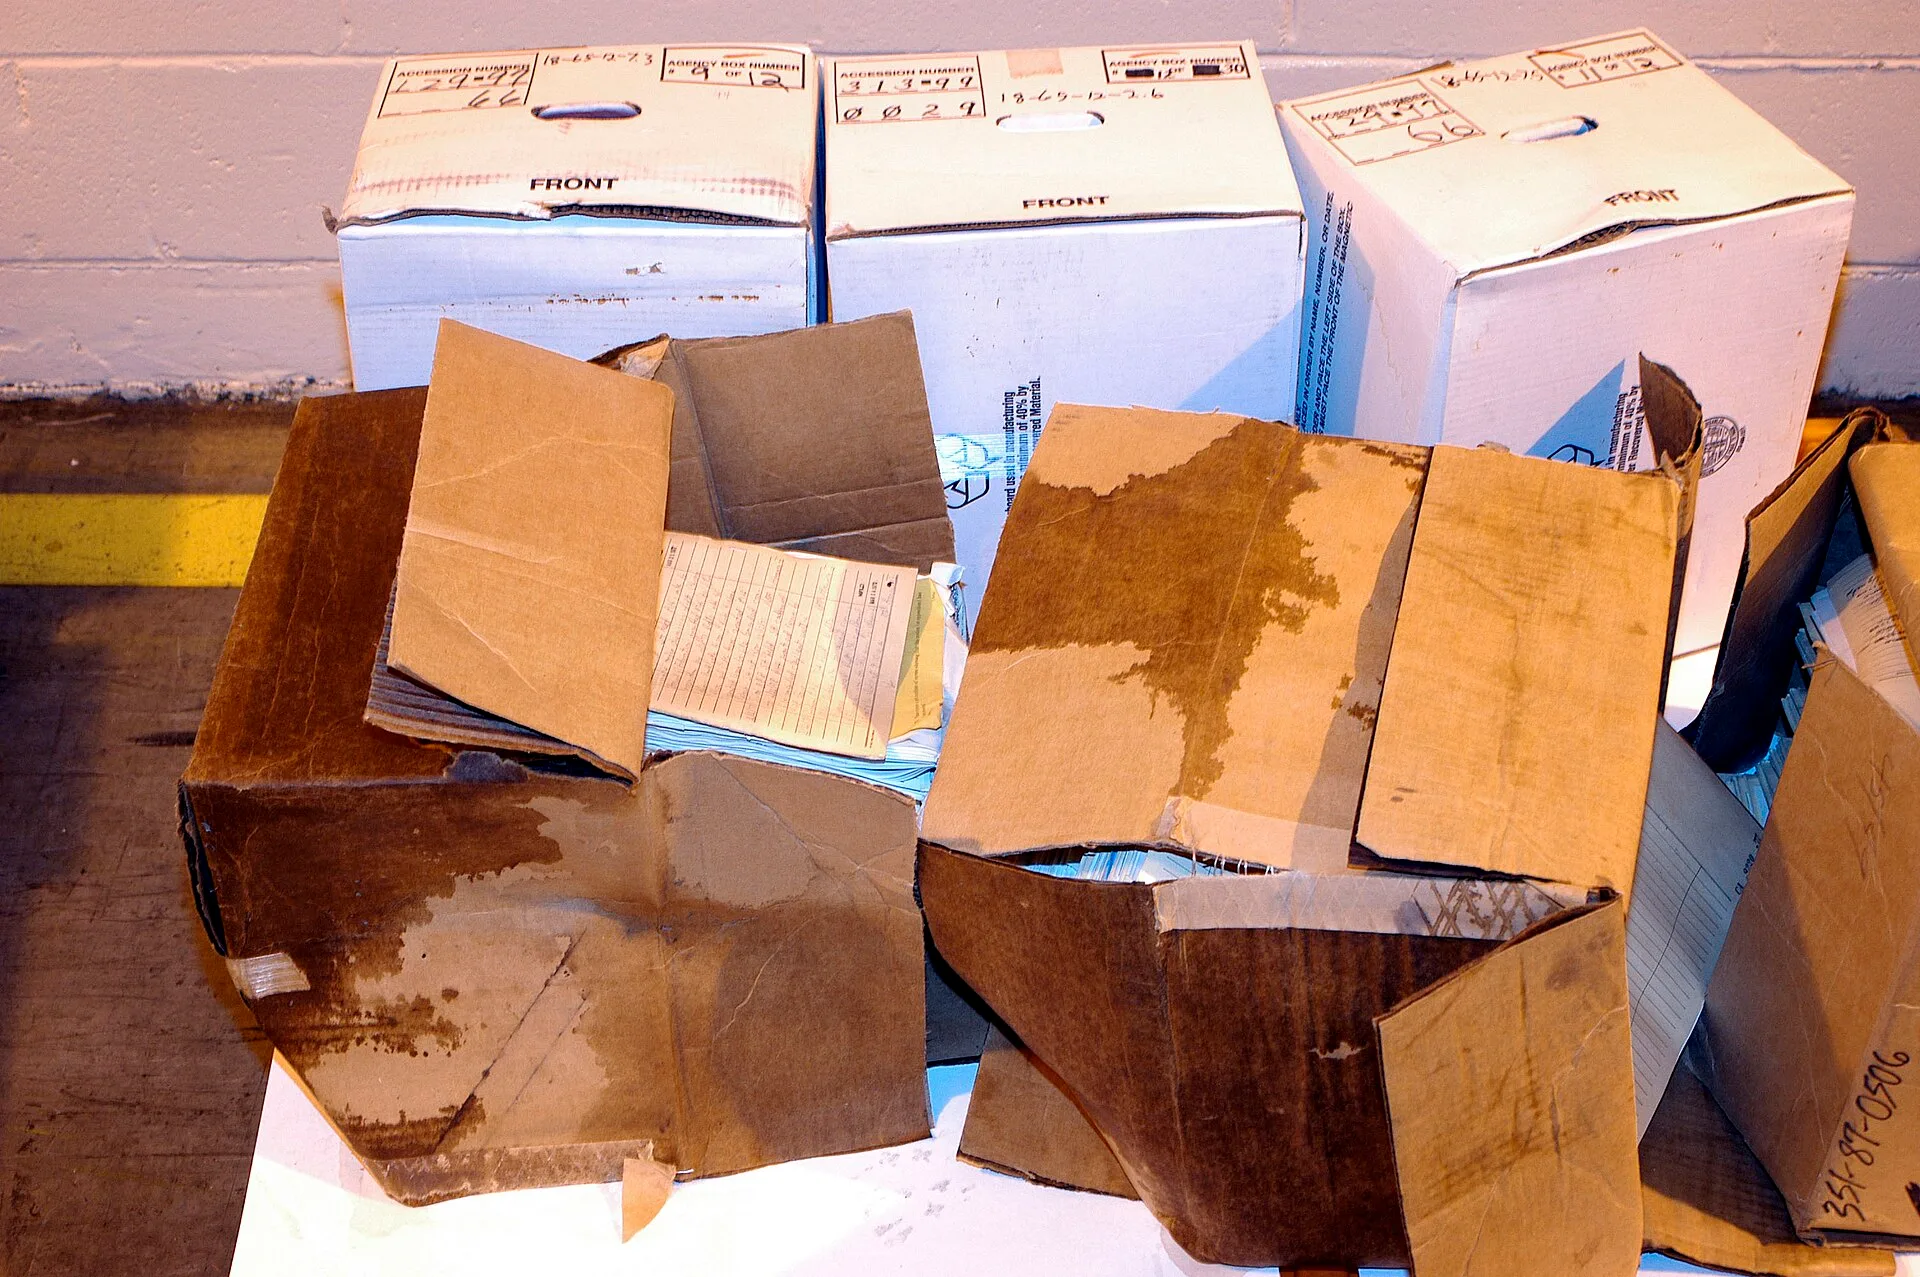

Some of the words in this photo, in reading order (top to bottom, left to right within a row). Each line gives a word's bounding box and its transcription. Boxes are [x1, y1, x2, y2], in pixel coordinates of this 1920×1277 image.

[397, 66, 472, 77] ACCESSION
[475, 64, 530, 73] NUMBER
[668, 60, 717, 68] AGENCY
[721, 61, 746, 69] BOX
[749, 63, 800, 72] NUMBER
[840, 69, 915, 79] ACCESSION
[919, 66, 975, 75] NUMBER
[1109, 59, 1158, 67] AGENCY
[1190, 57, 1241, 65] NUMBER
[749, 71, 789, 92] 12
[530, 177, 618, 191] FRONT
[1022, 195, 1110, 210] FRONT
[1603, 189, 1680, 206] FRONT
[1322, 224, 1329, 243] OR
[1340, 201, 1353, 263] MAGNETIC
[1333, 234, 1342, 258] THE
[1331, 259, 1338, 277] OF
[1336, 262, 1345, 287] THE
[1327, 277, 1336, 305] SIDE
[1334, 287, 1341, 305] OF
[1323, 304, 1332, 334] LEFT
[1329, 304, 1339, 345] FRONT
[1308, 332, 1315, 349] BY
[1321, 333, 1329, 356] THE
[1326, 344, 1334, 366] THE
[1305, 349, 1314, 387] ORDER
[1317, 356, 1326, 387] FACE
[1016, 385, 1029, 397] by
[1323, 368, 1331, 398] FACE
[1629, 386, 1640, 396] by
[1029, 376, 1041, 417] Material.
[1303, 387, 1310, 401] IN
[1016, 399, 1028, 420] 40%
[1319, 396, 1328, 429] MUST
[1624, 399, 1637, 419] 40%
[1002, 391, 1015, 453] manufacturing
[1017, 421, 1028, 431] of
[1312, 411, 1320, 433] DER
[1609, 392, 1629, 455] manufacturing
[1623, 421, 1632, 431] of
[1628, 415, 1645, 462] Recovered
[1004, 465, 1016, 486] used
